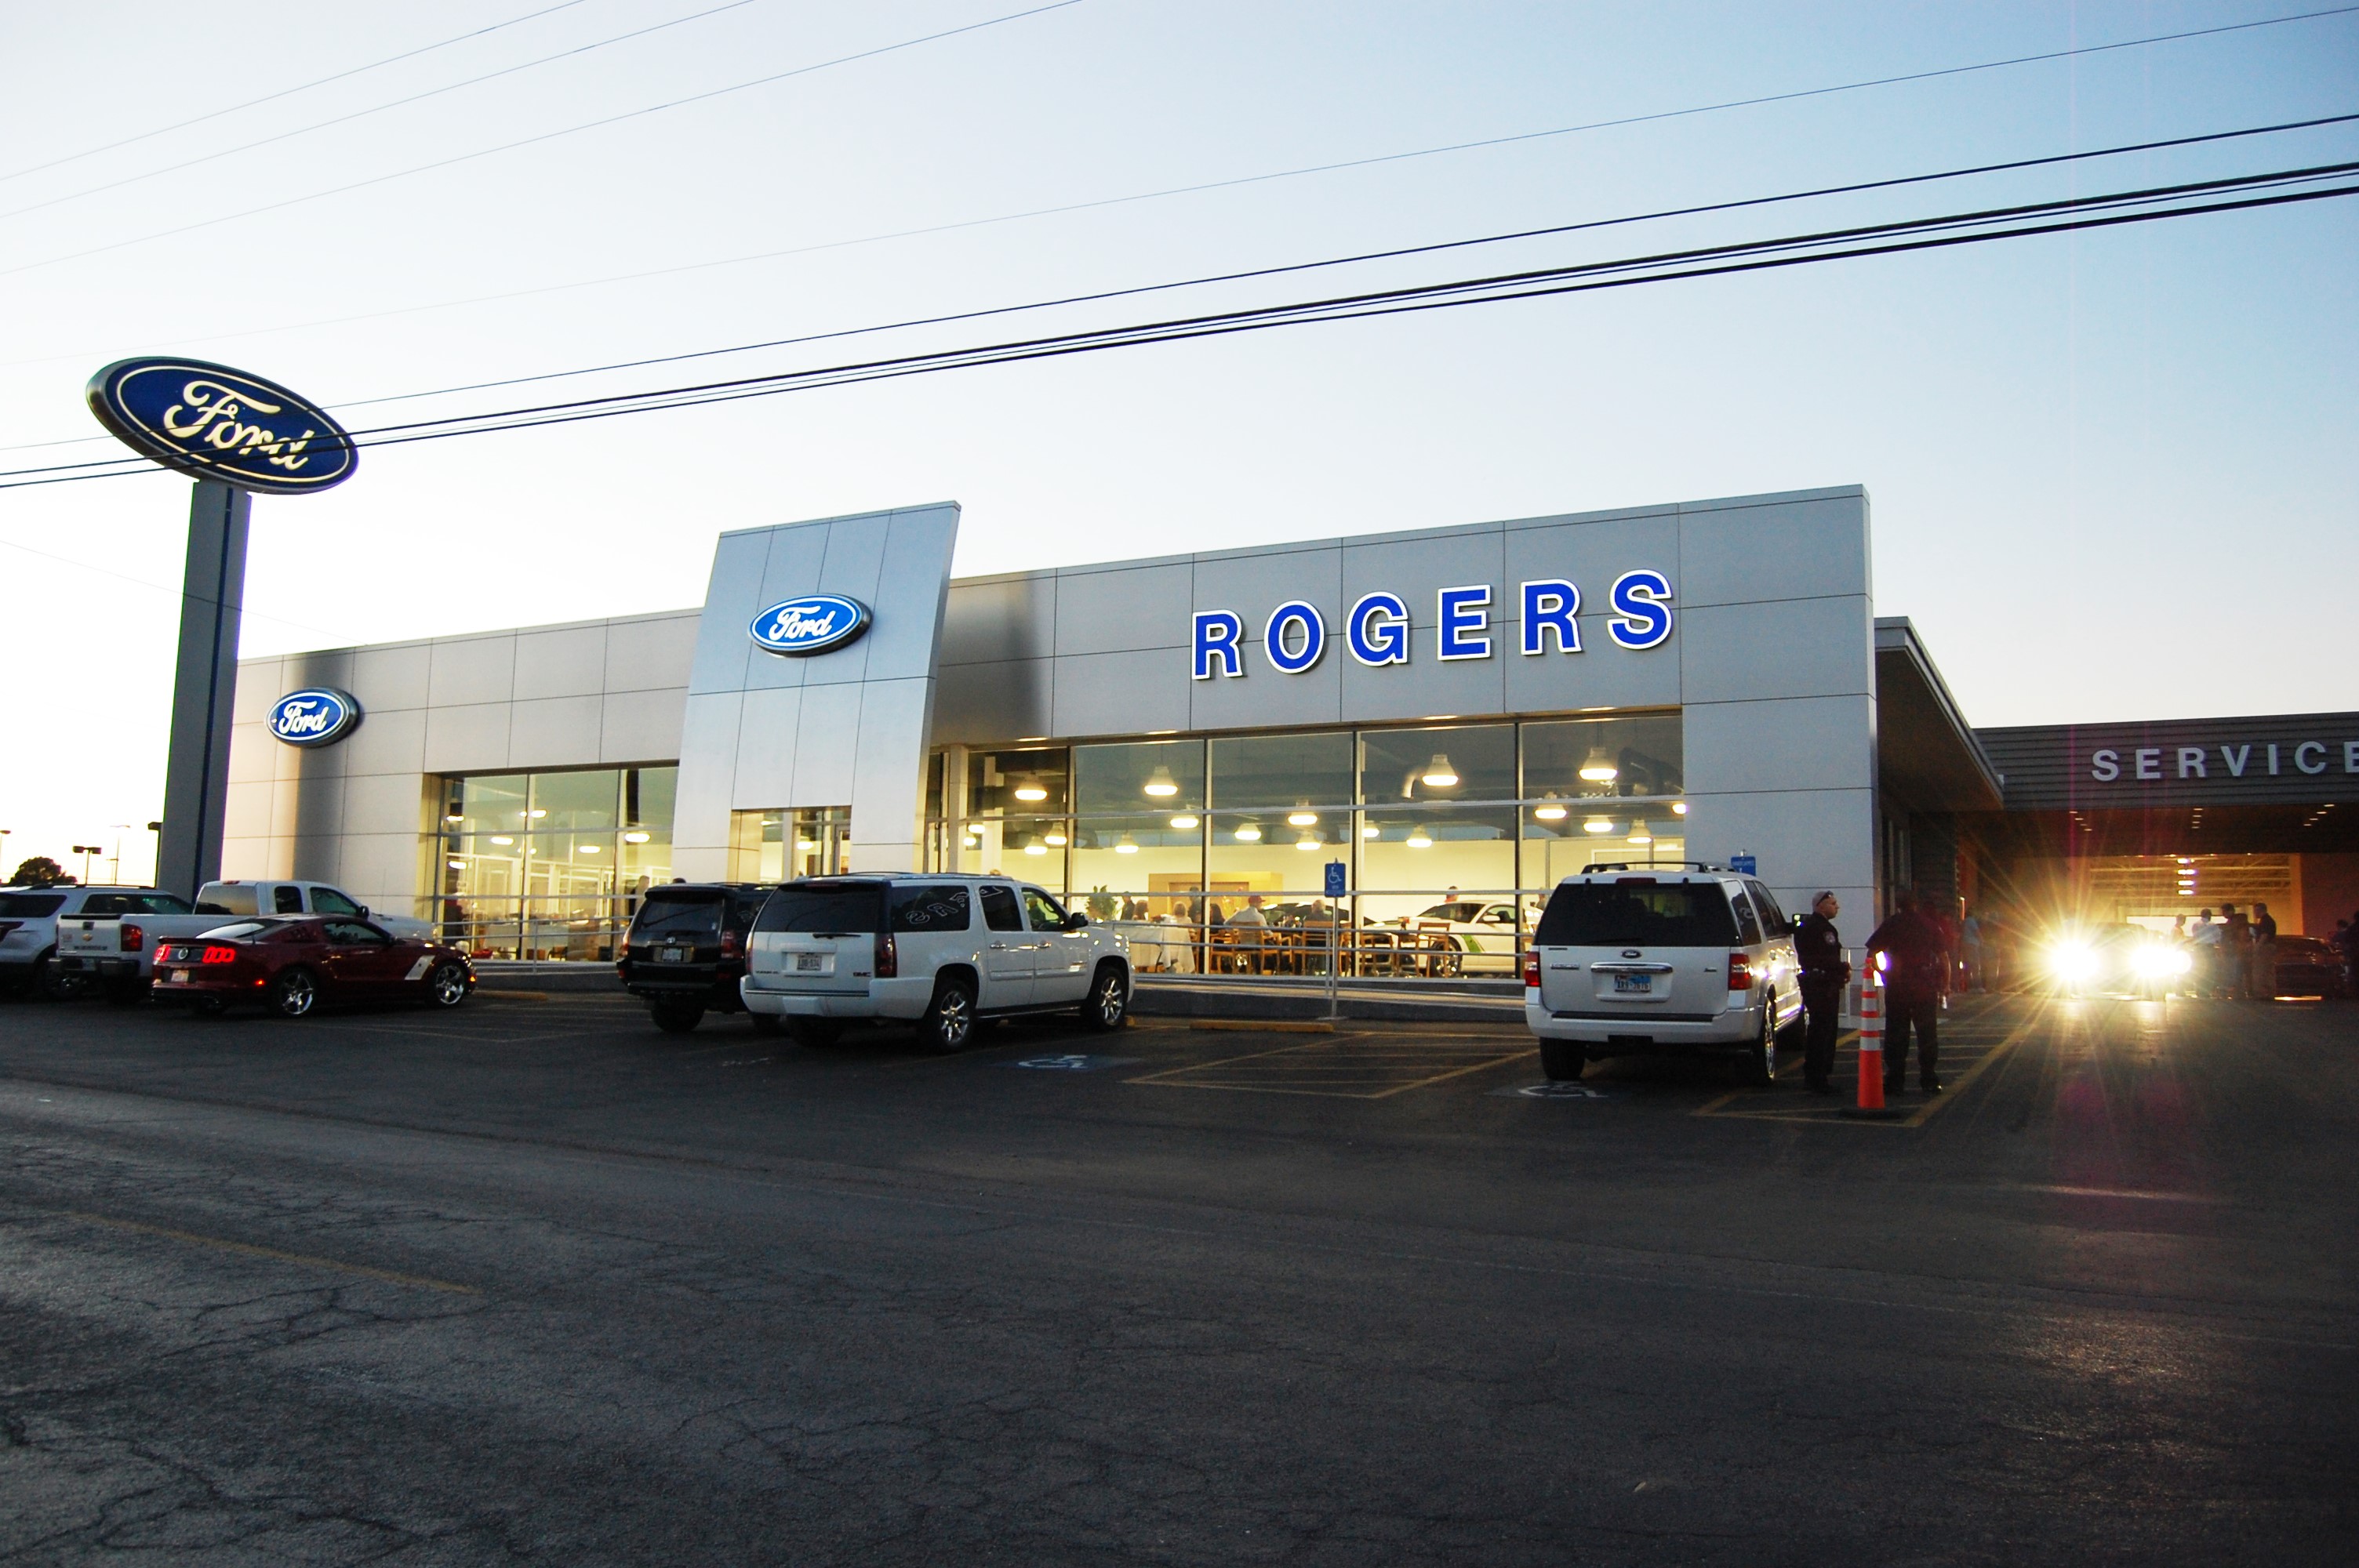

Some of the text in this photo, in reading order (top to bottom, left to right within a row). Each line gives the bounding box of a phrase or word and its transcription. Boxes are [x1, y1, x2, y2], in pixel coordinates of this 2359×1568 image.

[163, 380, 314, 470] Ford
[768, 605, 837, 642] Ford
[1191, 568, 1674, 681] ROGERS
[278, 700, 328, 735] Ford
[2092, 741, 2359, 782] SERVICE
